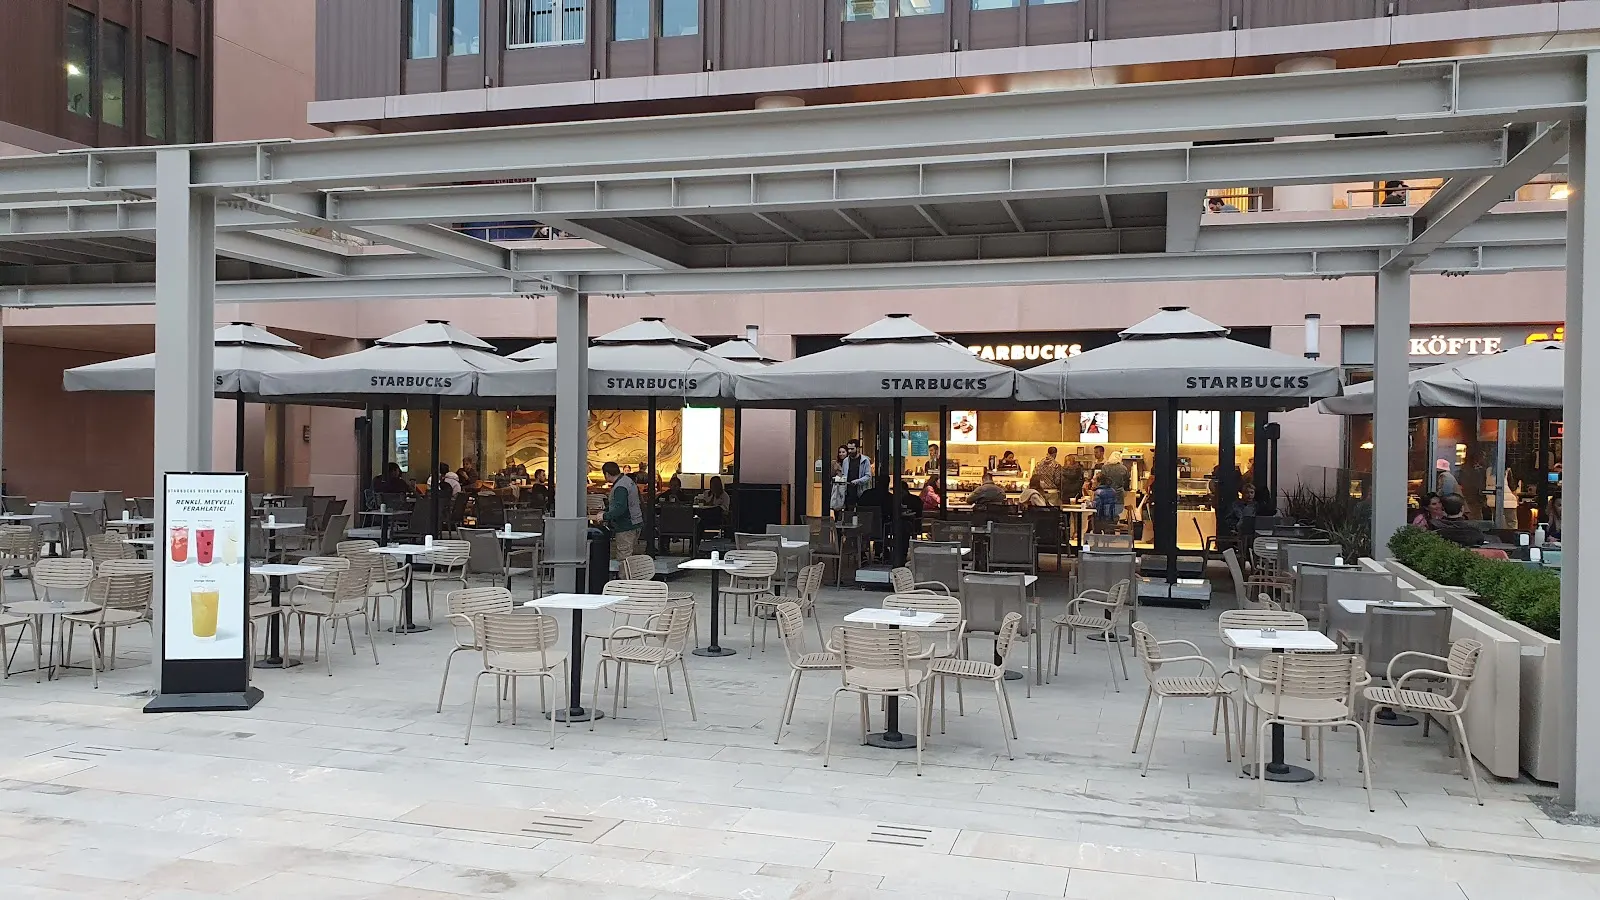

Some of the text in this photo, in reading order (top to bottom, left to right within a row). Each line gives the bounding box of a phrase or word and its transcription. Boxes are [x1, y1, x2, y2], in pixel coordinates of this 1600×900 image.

[1409, 334, 1502, 355] KÖFTE
[967, 343, 1082, 361] TARBUCKS
[370, 376, 452, 388] STARBUCKS
[607, 377, 698, 390] STARBUCKS
[881, 378, 987, 390] STARBUCKS
[1186, 376, 1309, 389] STARBUCKS
